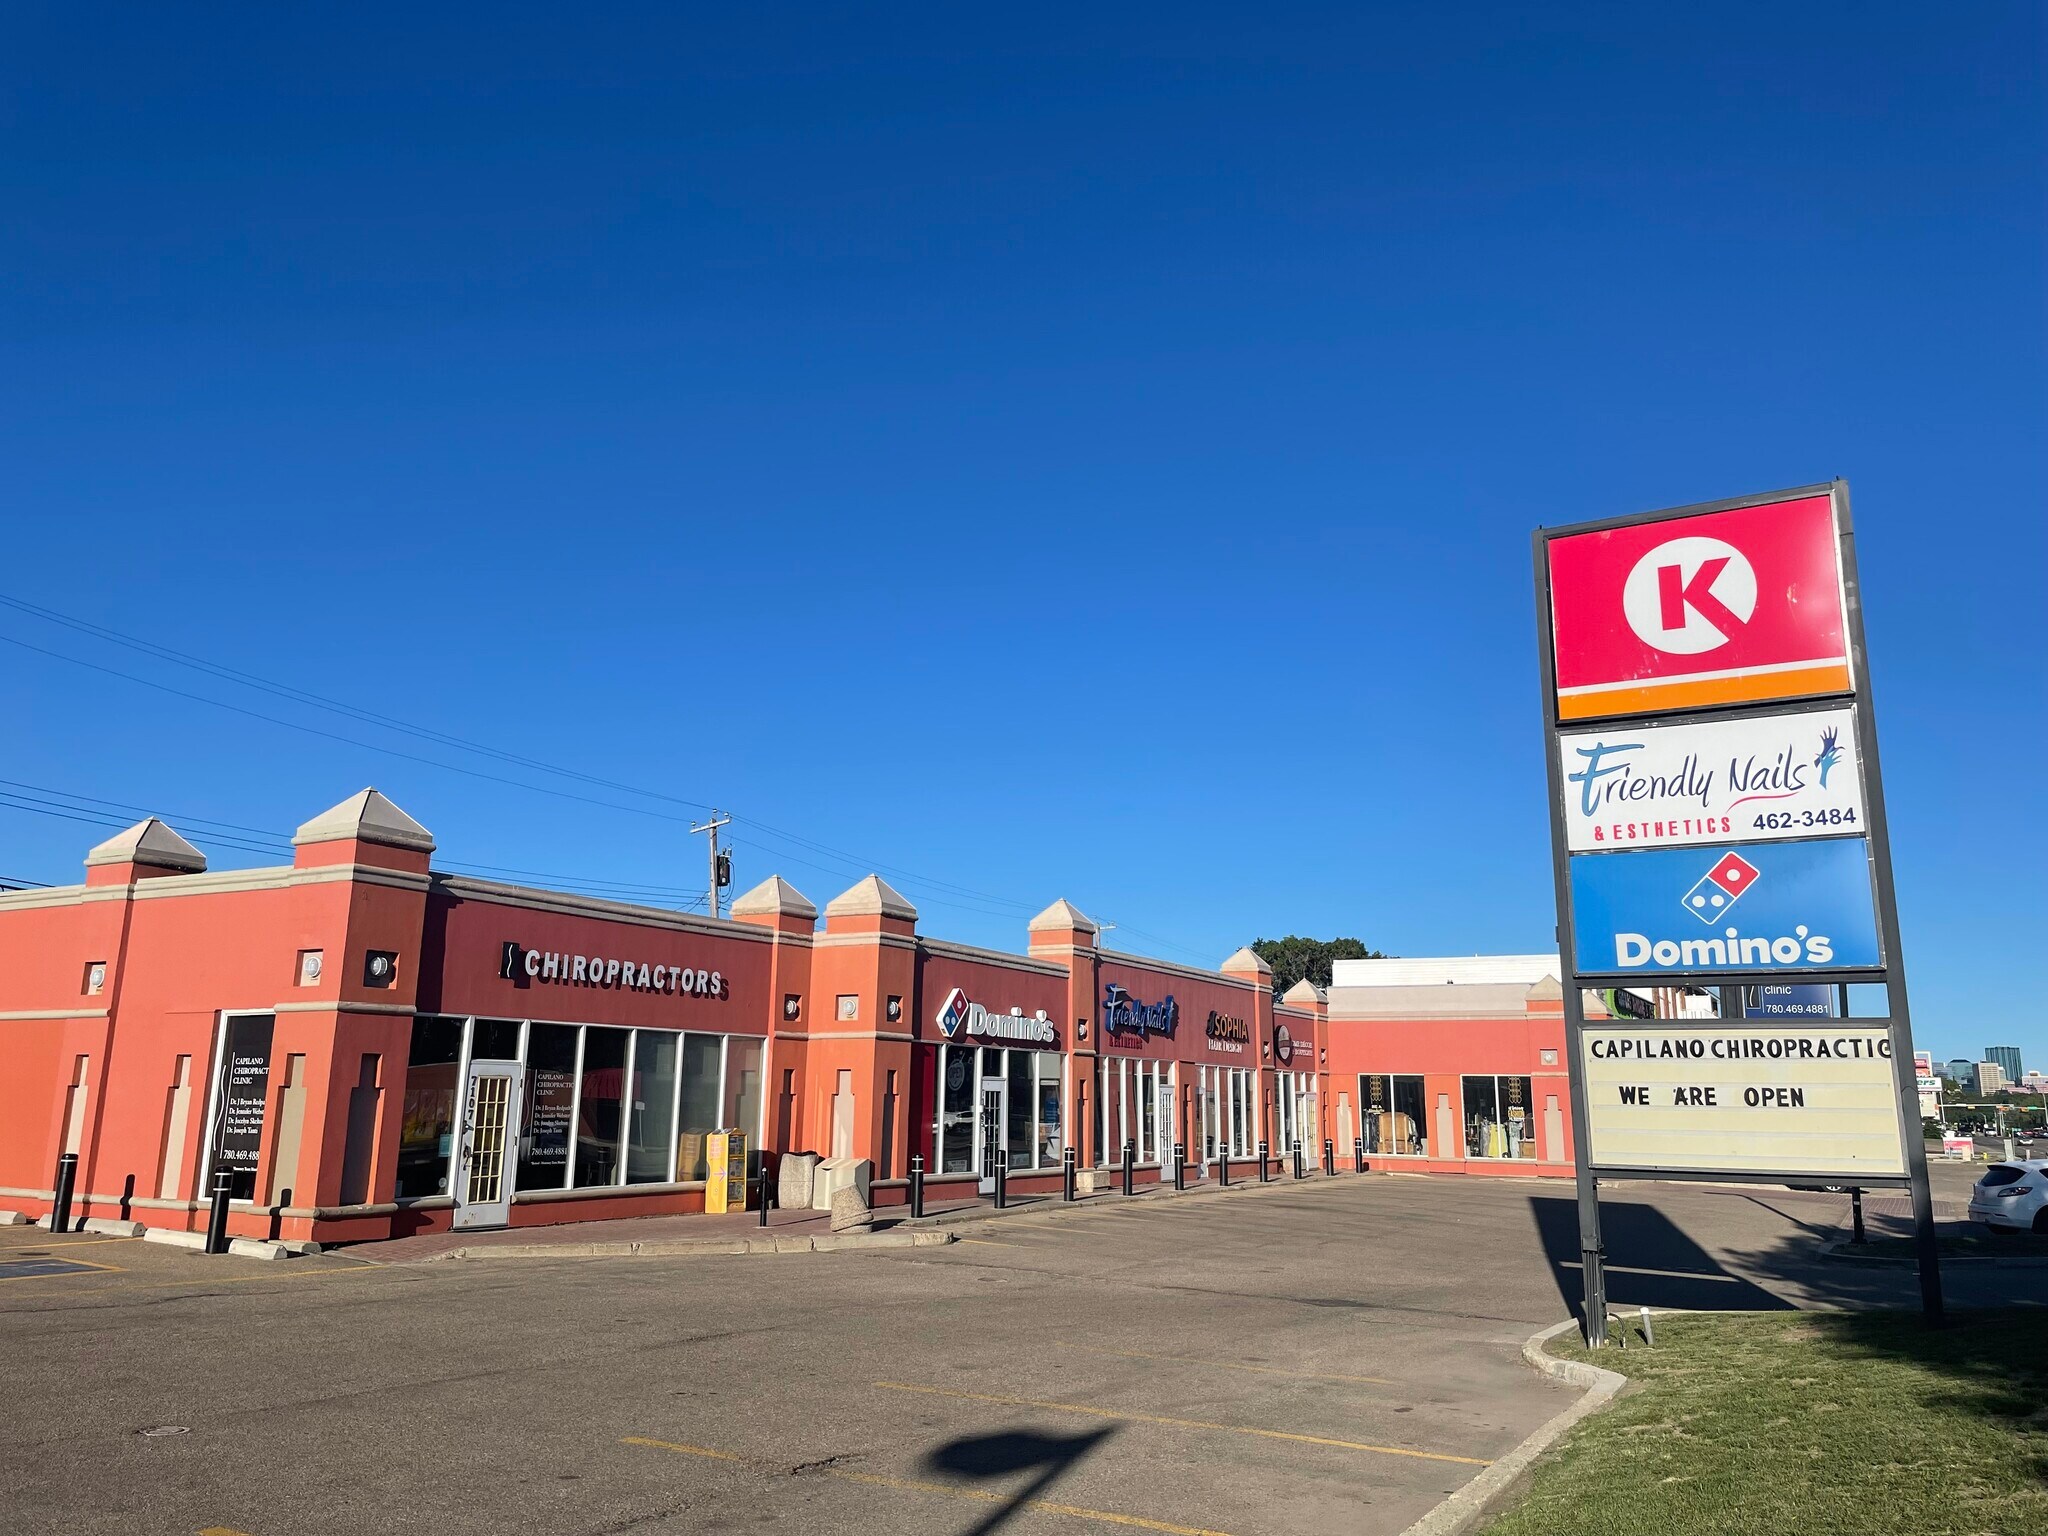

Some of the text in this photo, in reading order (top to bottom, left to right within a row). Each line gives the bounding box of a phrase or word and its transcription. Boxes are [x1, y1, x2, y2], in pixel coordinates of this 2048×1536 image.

[1658, 557, 1748, 640] K
[1568, 742, 1808, 817] Friendly Nails
[1594, 817, 1731, 841] & ESTHETICS
[1753, 807, 1857, 830] 462-3484
[1615, 925, 1834, 967] Domino's
[524, 949, 722, 995] CHIROPRACTORS
[1764, 985, 1792, 994] clinic
[1766, 1004, 1828, 1013] 780.469.4881
[966, 1002, 1054, 1042] Domino's
[1214, 1014, 1248, 1039] SOPHIA
[1591, 1039, 1705, 1058] CAPILANO
[235, 1057, 264, 1065] CAPILANO
[467, 1075, 478, 1120] 7107
[1619, 1086, 1804, 1107] WE ARE OPEN
[531, 1147, 568, 1156] 780.469.4881
